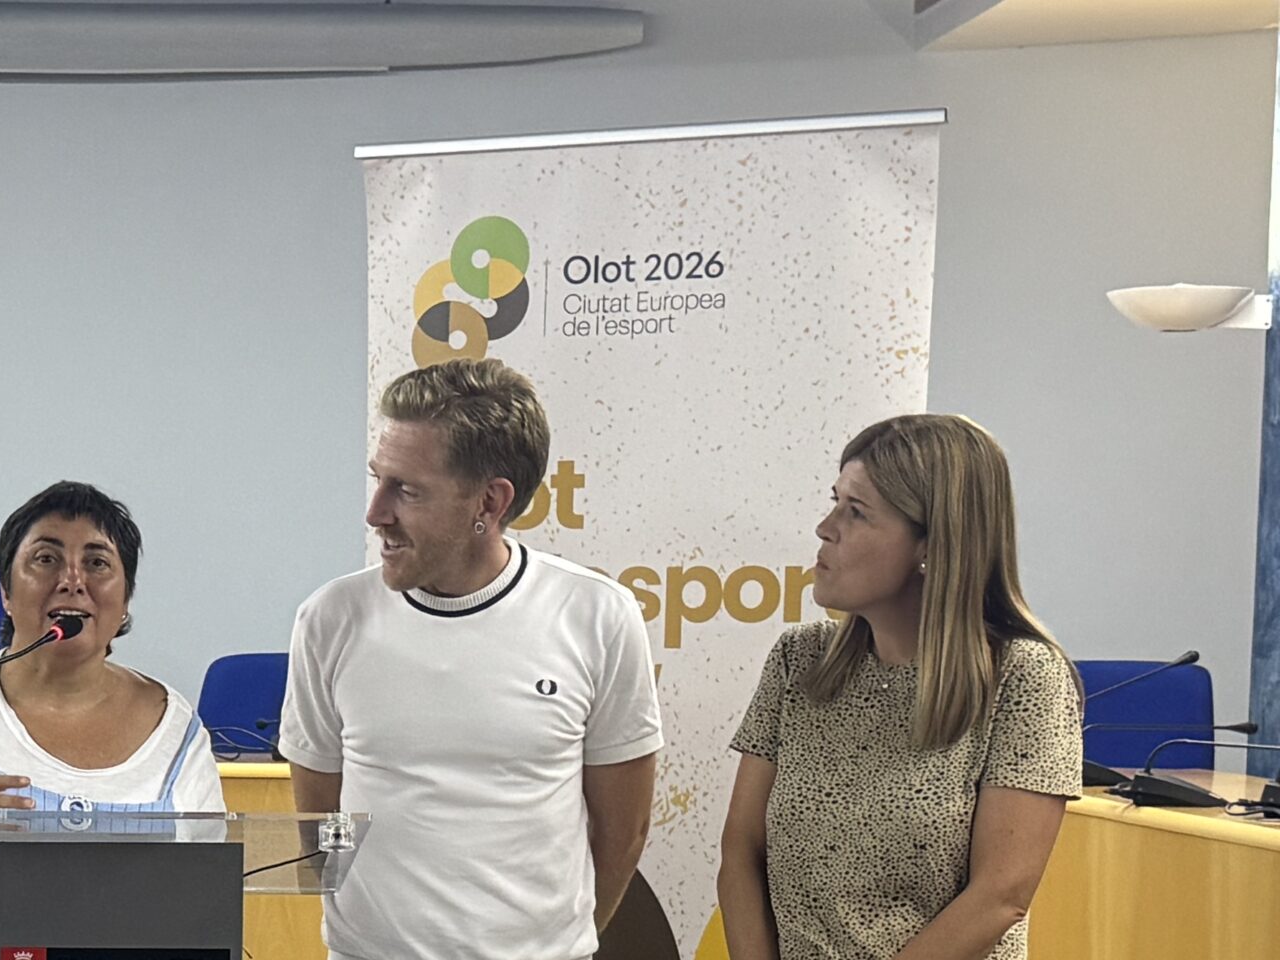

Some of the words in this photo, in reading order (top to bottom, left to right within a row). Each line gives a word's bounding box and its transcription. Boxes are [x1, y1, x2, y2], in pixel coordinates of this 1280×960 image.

[563, 254, 636, 285] Olot
[644, 250, 724, 282] 2026
[563, 293, 631, 315] Ciutat
[636, 291, 726, 315] Europea
[562, 316, 591, 337] de
[595, 314, 676, 339] l'esport
[587, 566, 848, 649] spor
